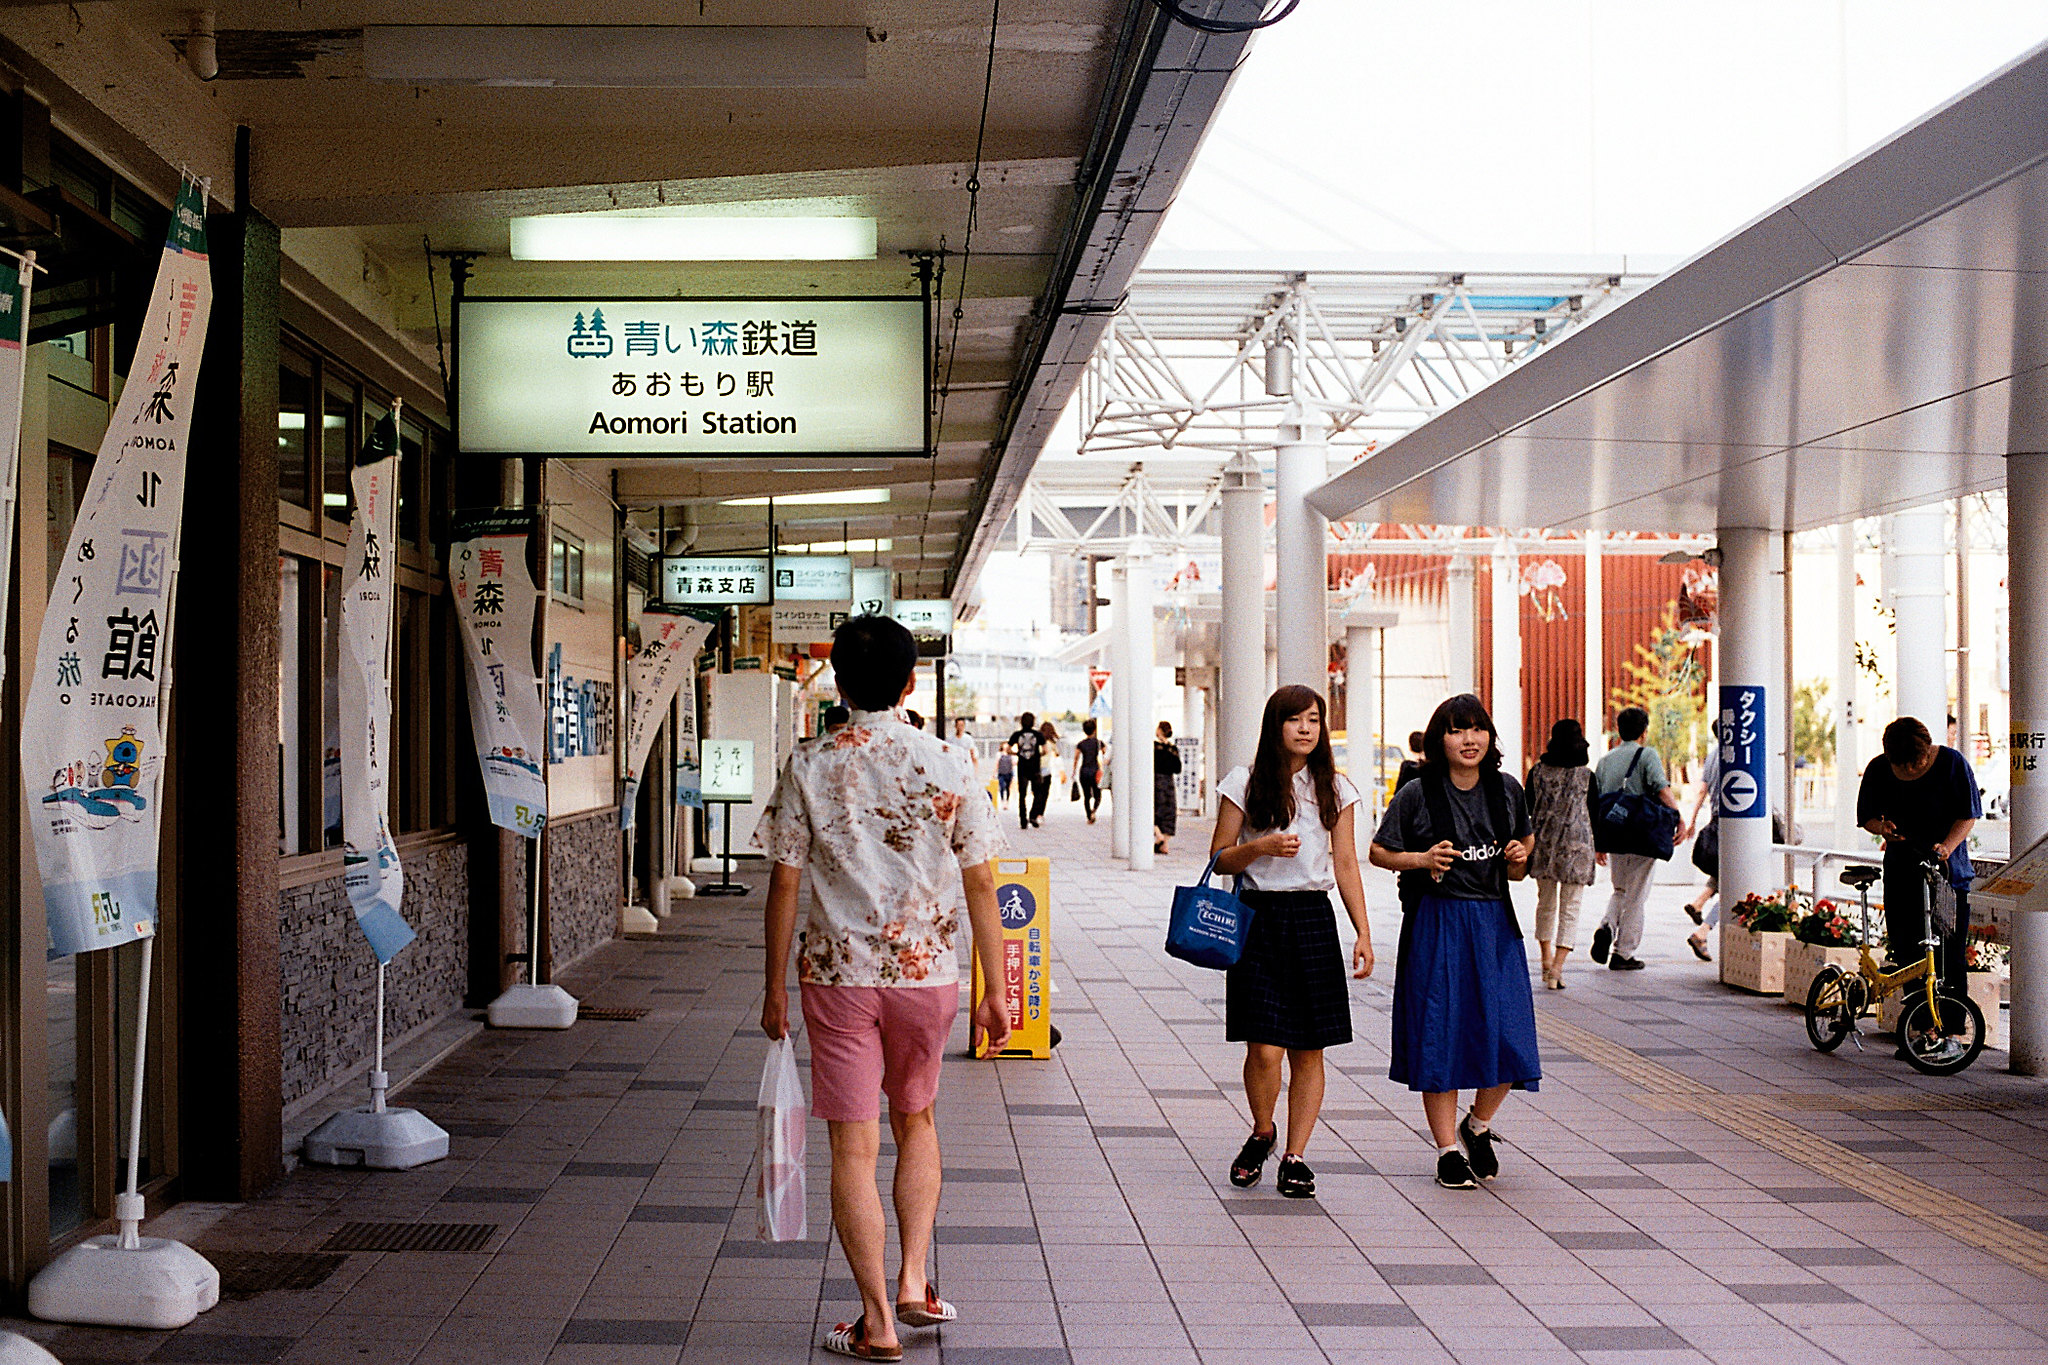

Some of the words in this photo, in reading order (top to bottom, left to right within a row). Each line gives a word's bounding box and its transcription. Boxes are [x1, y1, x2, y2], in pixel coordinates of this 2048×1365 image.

[624, 319, 819, 357] 青い森鉄道
[611, 370, 775, 398] あおもり駅
[588, 411, 688, 435] Aomori
[702, 411, 798, 435] Station
[676, 576, 756, 594] 青森支店
[774, 611, 828, 619] コインロッカー
[1739, 690, 1757, 765] タクシー
[711, 746, 724, 788] うどん
[1028, 927, 1041, 1020] 自転車から降り
